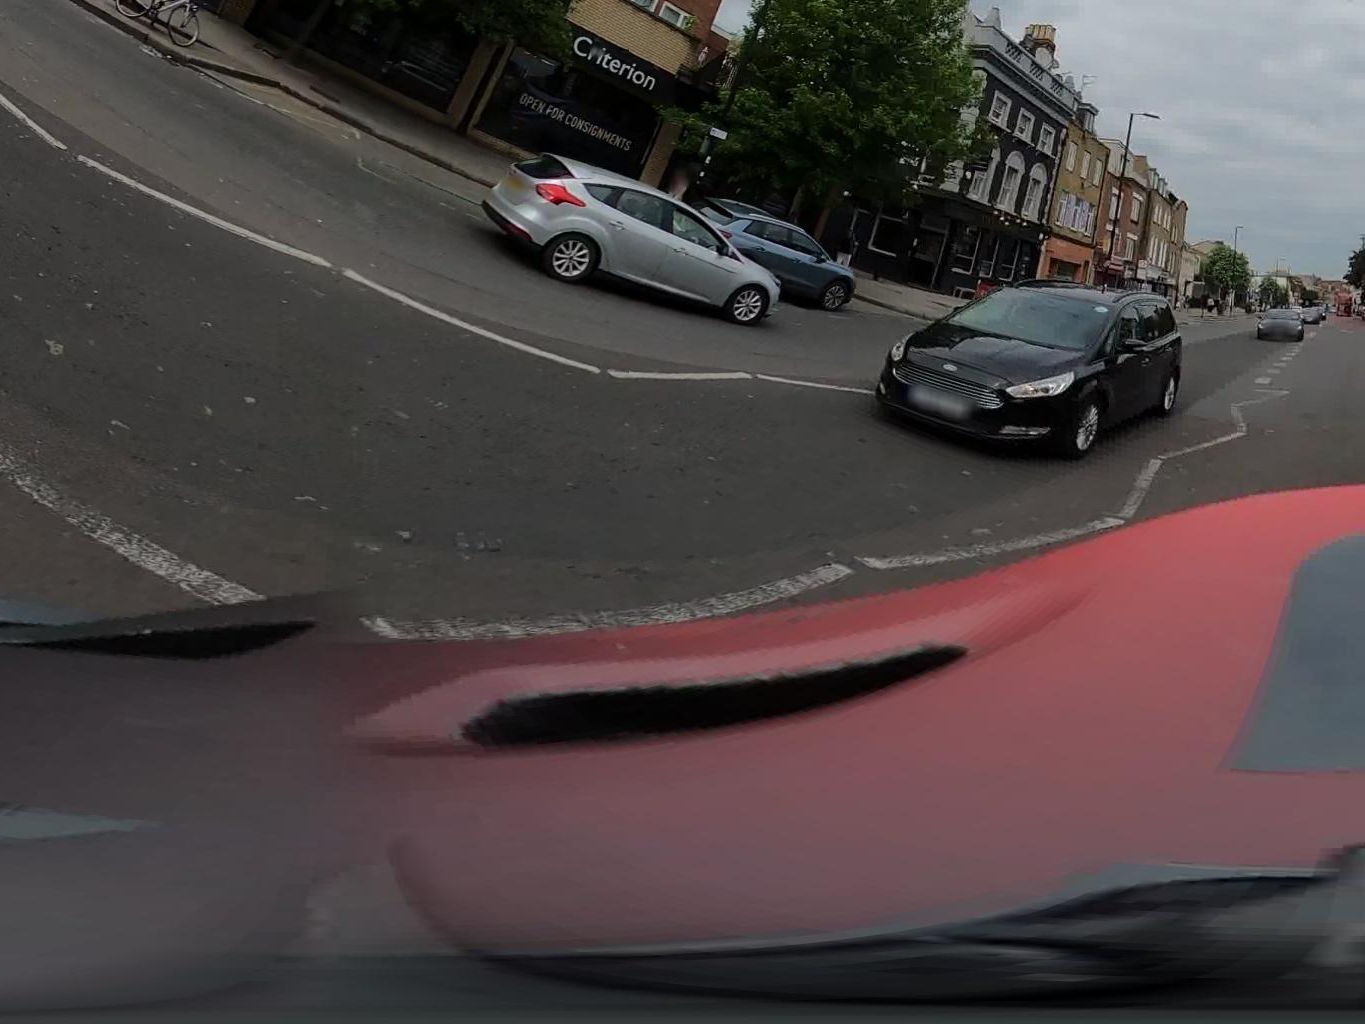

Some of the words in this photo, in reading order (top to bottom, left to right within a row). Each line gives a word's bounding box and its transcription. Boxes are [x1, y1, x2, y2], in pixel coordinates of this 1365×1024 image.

[519, 93, 546, 114] OPEN
[545, 105, 566, 122] FOR
[564, 113, 632, 151] CONSIGNMENTS
